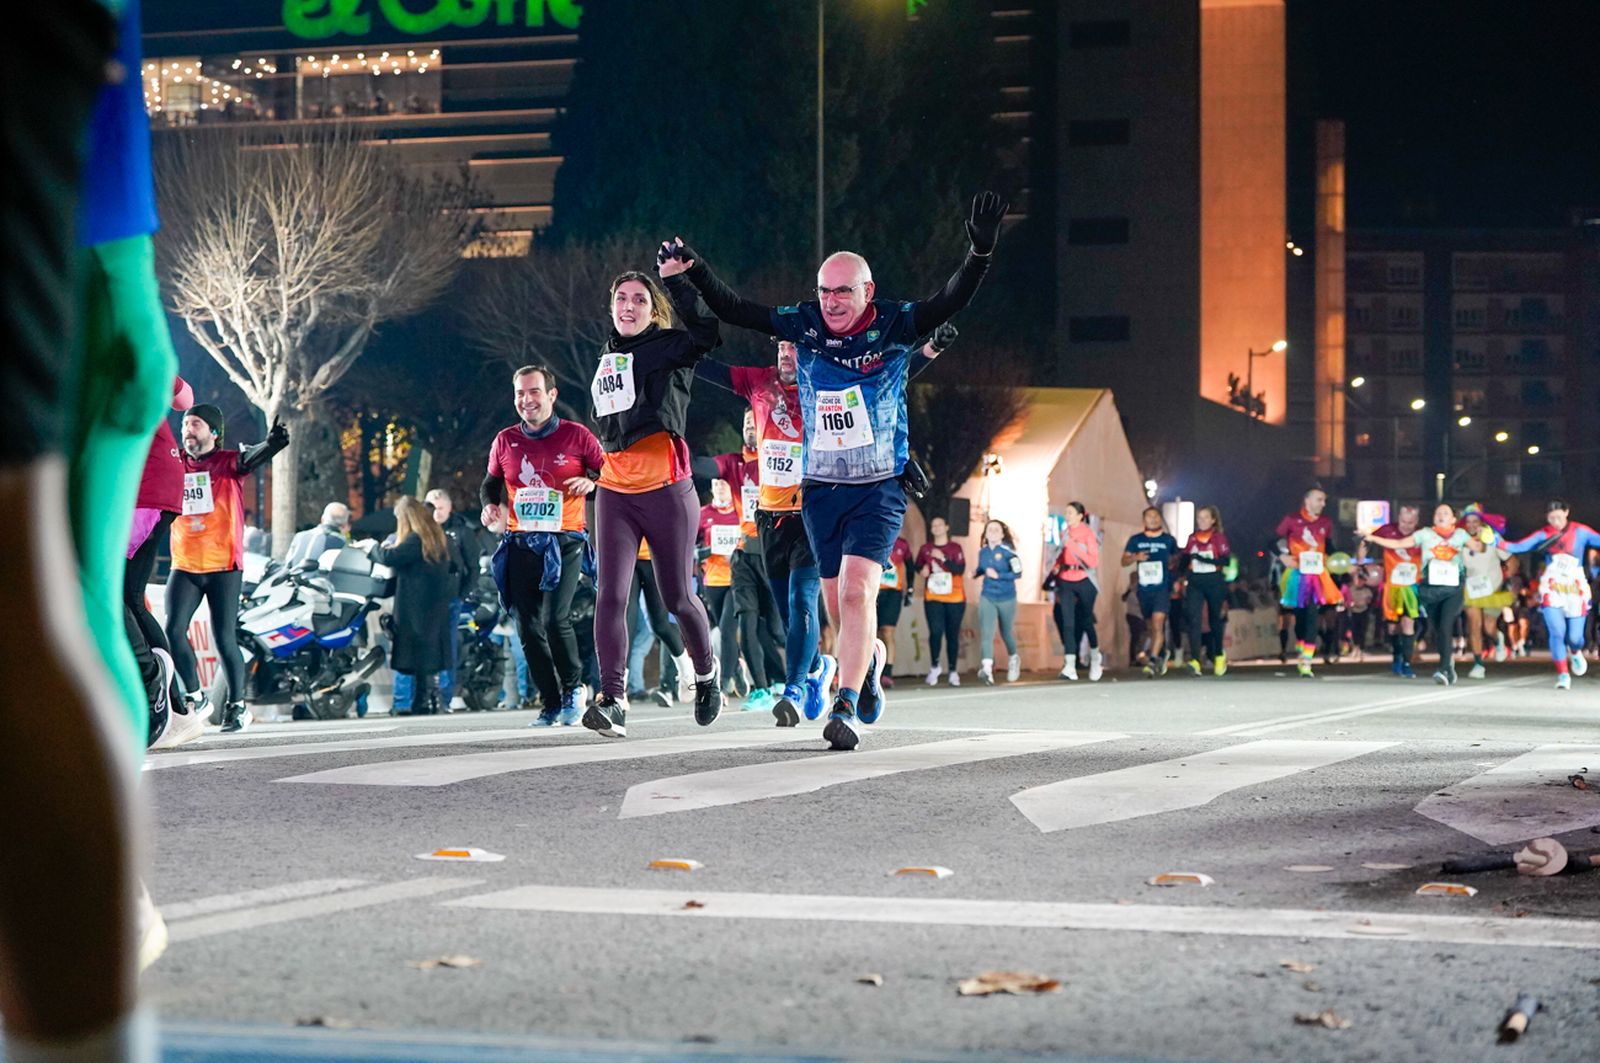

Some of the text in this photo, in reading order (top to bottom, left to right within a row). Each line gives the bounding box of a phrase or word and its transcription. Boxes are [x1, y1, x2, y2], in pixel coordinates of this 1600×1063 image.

[597, 373, 623, 395] 2484
[822, 411, 854, 430] 1160
[520, 503, 555, 516] 12702
